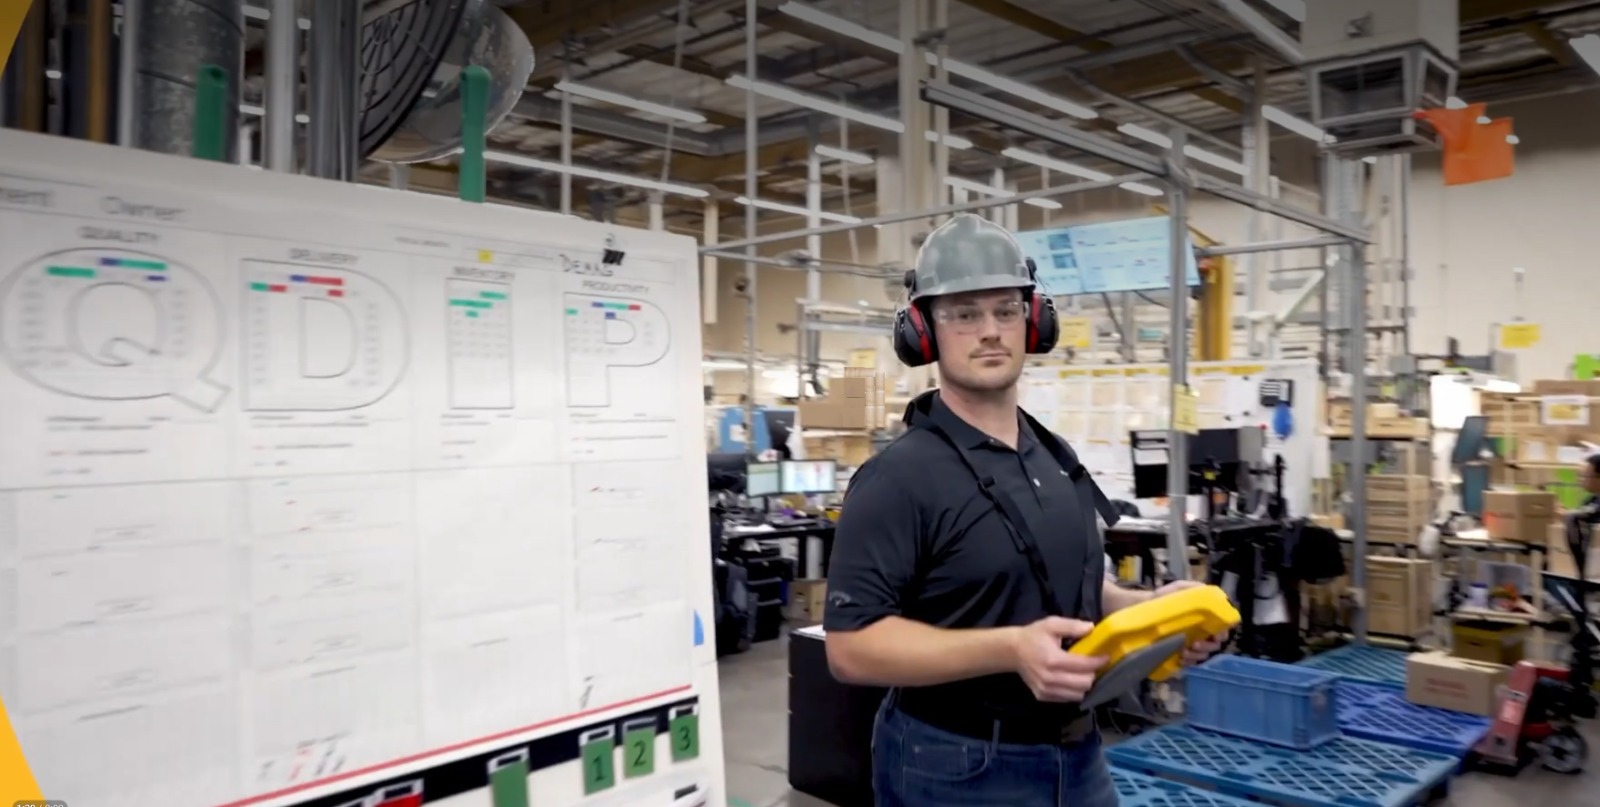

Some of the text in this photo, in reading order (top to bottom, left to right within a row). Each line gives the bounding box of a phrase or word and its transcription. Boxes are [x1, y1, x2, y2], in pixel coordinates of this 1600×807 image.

[582, 279, 649, 294] PRODUCTIVITY
[1, 246, 232, 414] Q
[239, 257, 411, 411] D
[562, 290, 672, 409] P
[679, 725, 691, 751] 3
[633, 740, 647, 767] 2
[592, 755, 606, 782] 1
